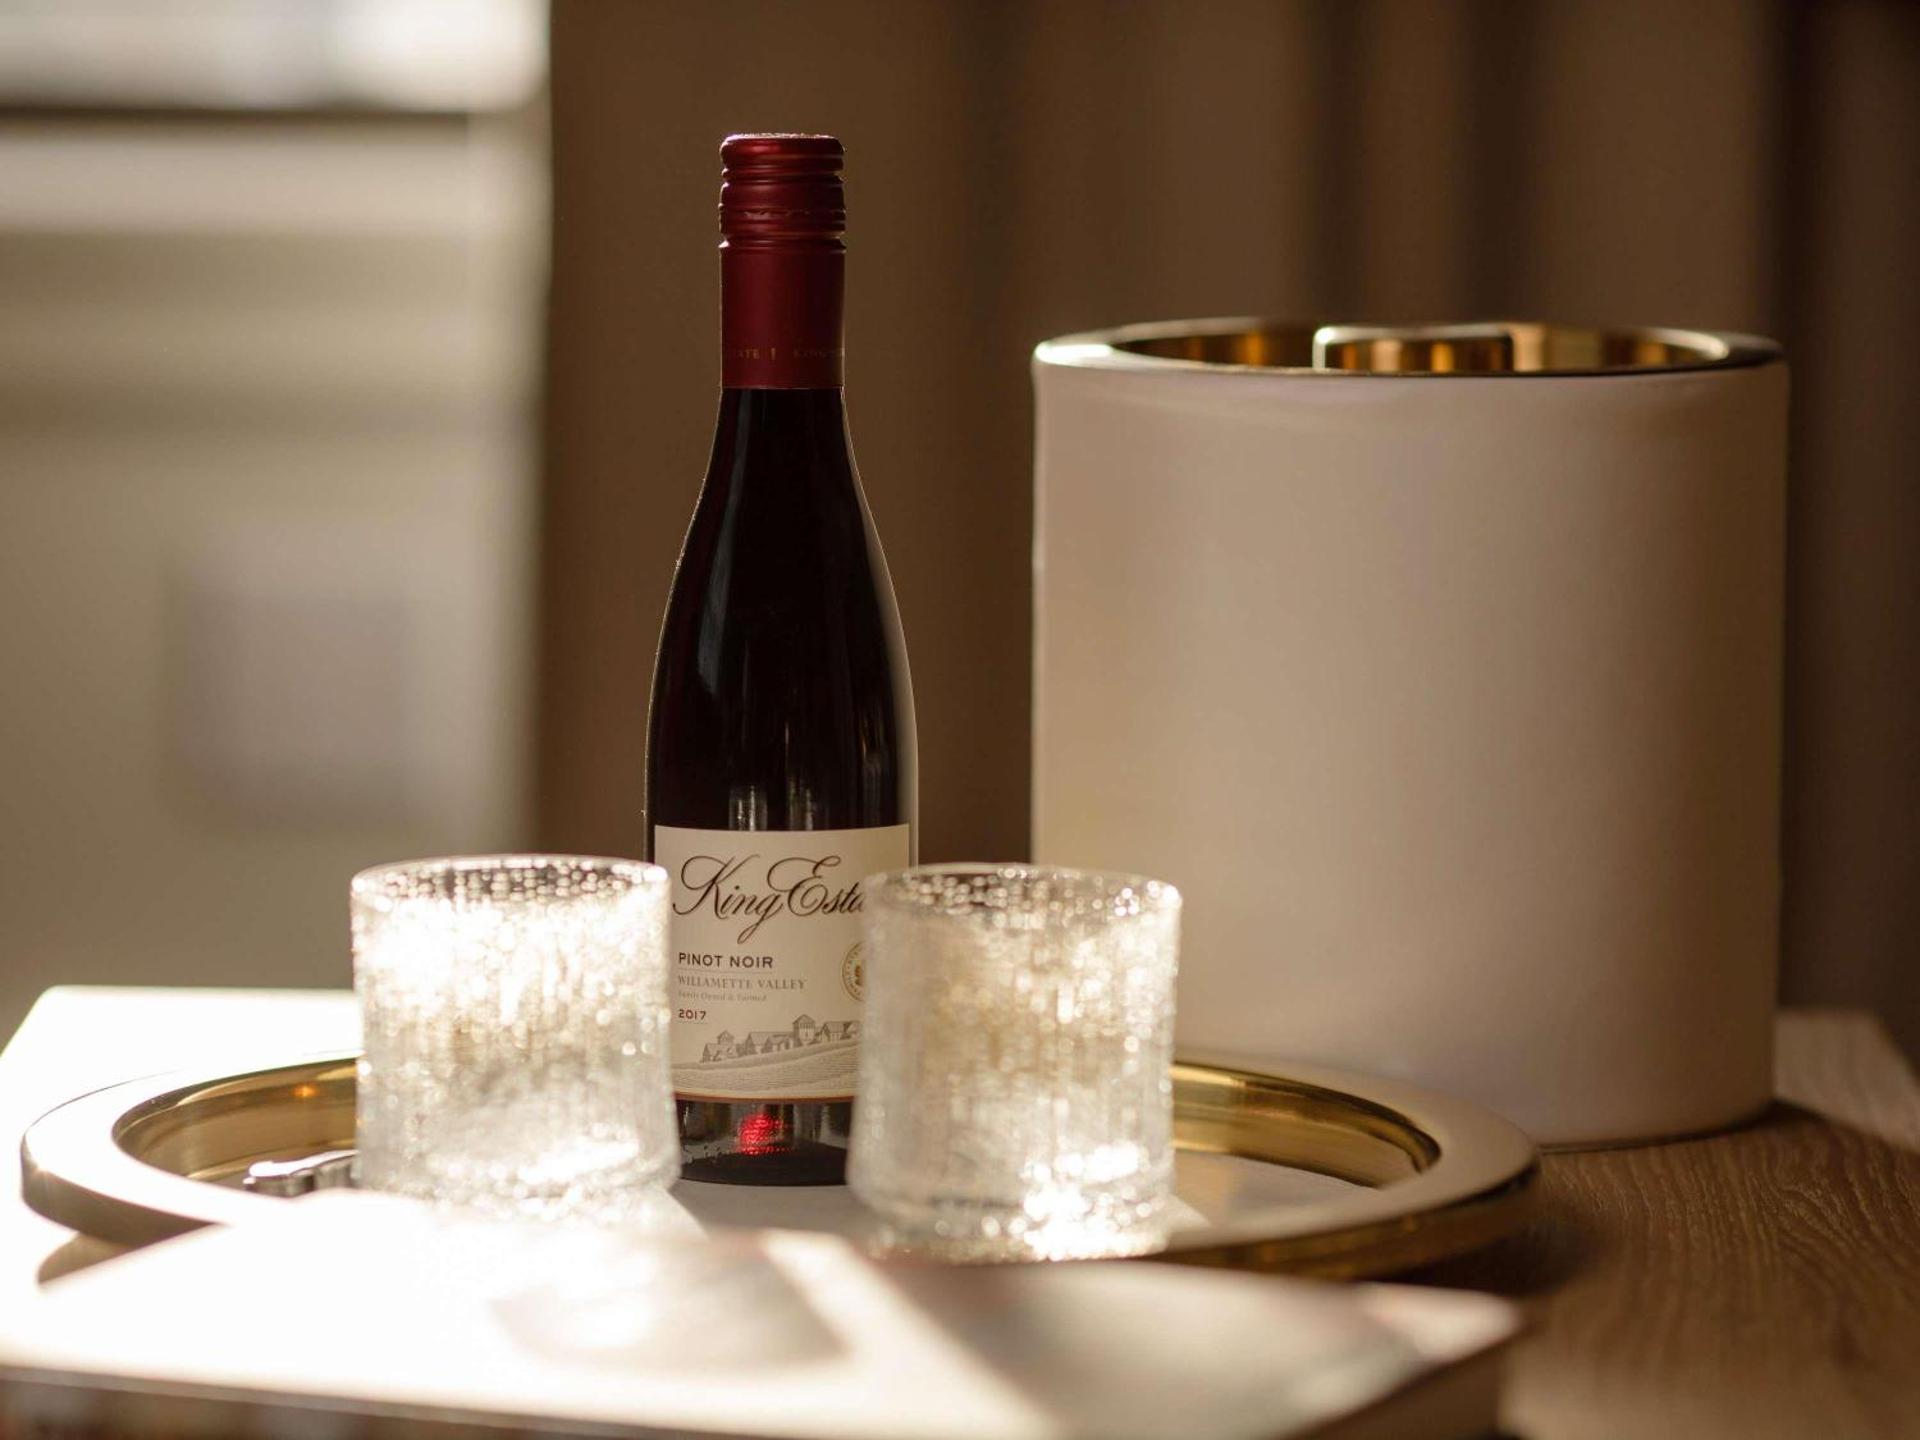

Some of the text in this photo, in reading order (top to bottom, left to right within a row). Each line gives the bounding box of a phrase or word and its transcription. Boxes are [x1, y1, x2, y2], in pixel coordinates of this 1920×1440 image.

[673, 854, 865, 944] King Esta
[678, 952, 774, 969] PINOT NOIR
[678, 975, 807, 991] WILLAMETTE VALLEY
[678, 1008, 708, 1020] 2017
